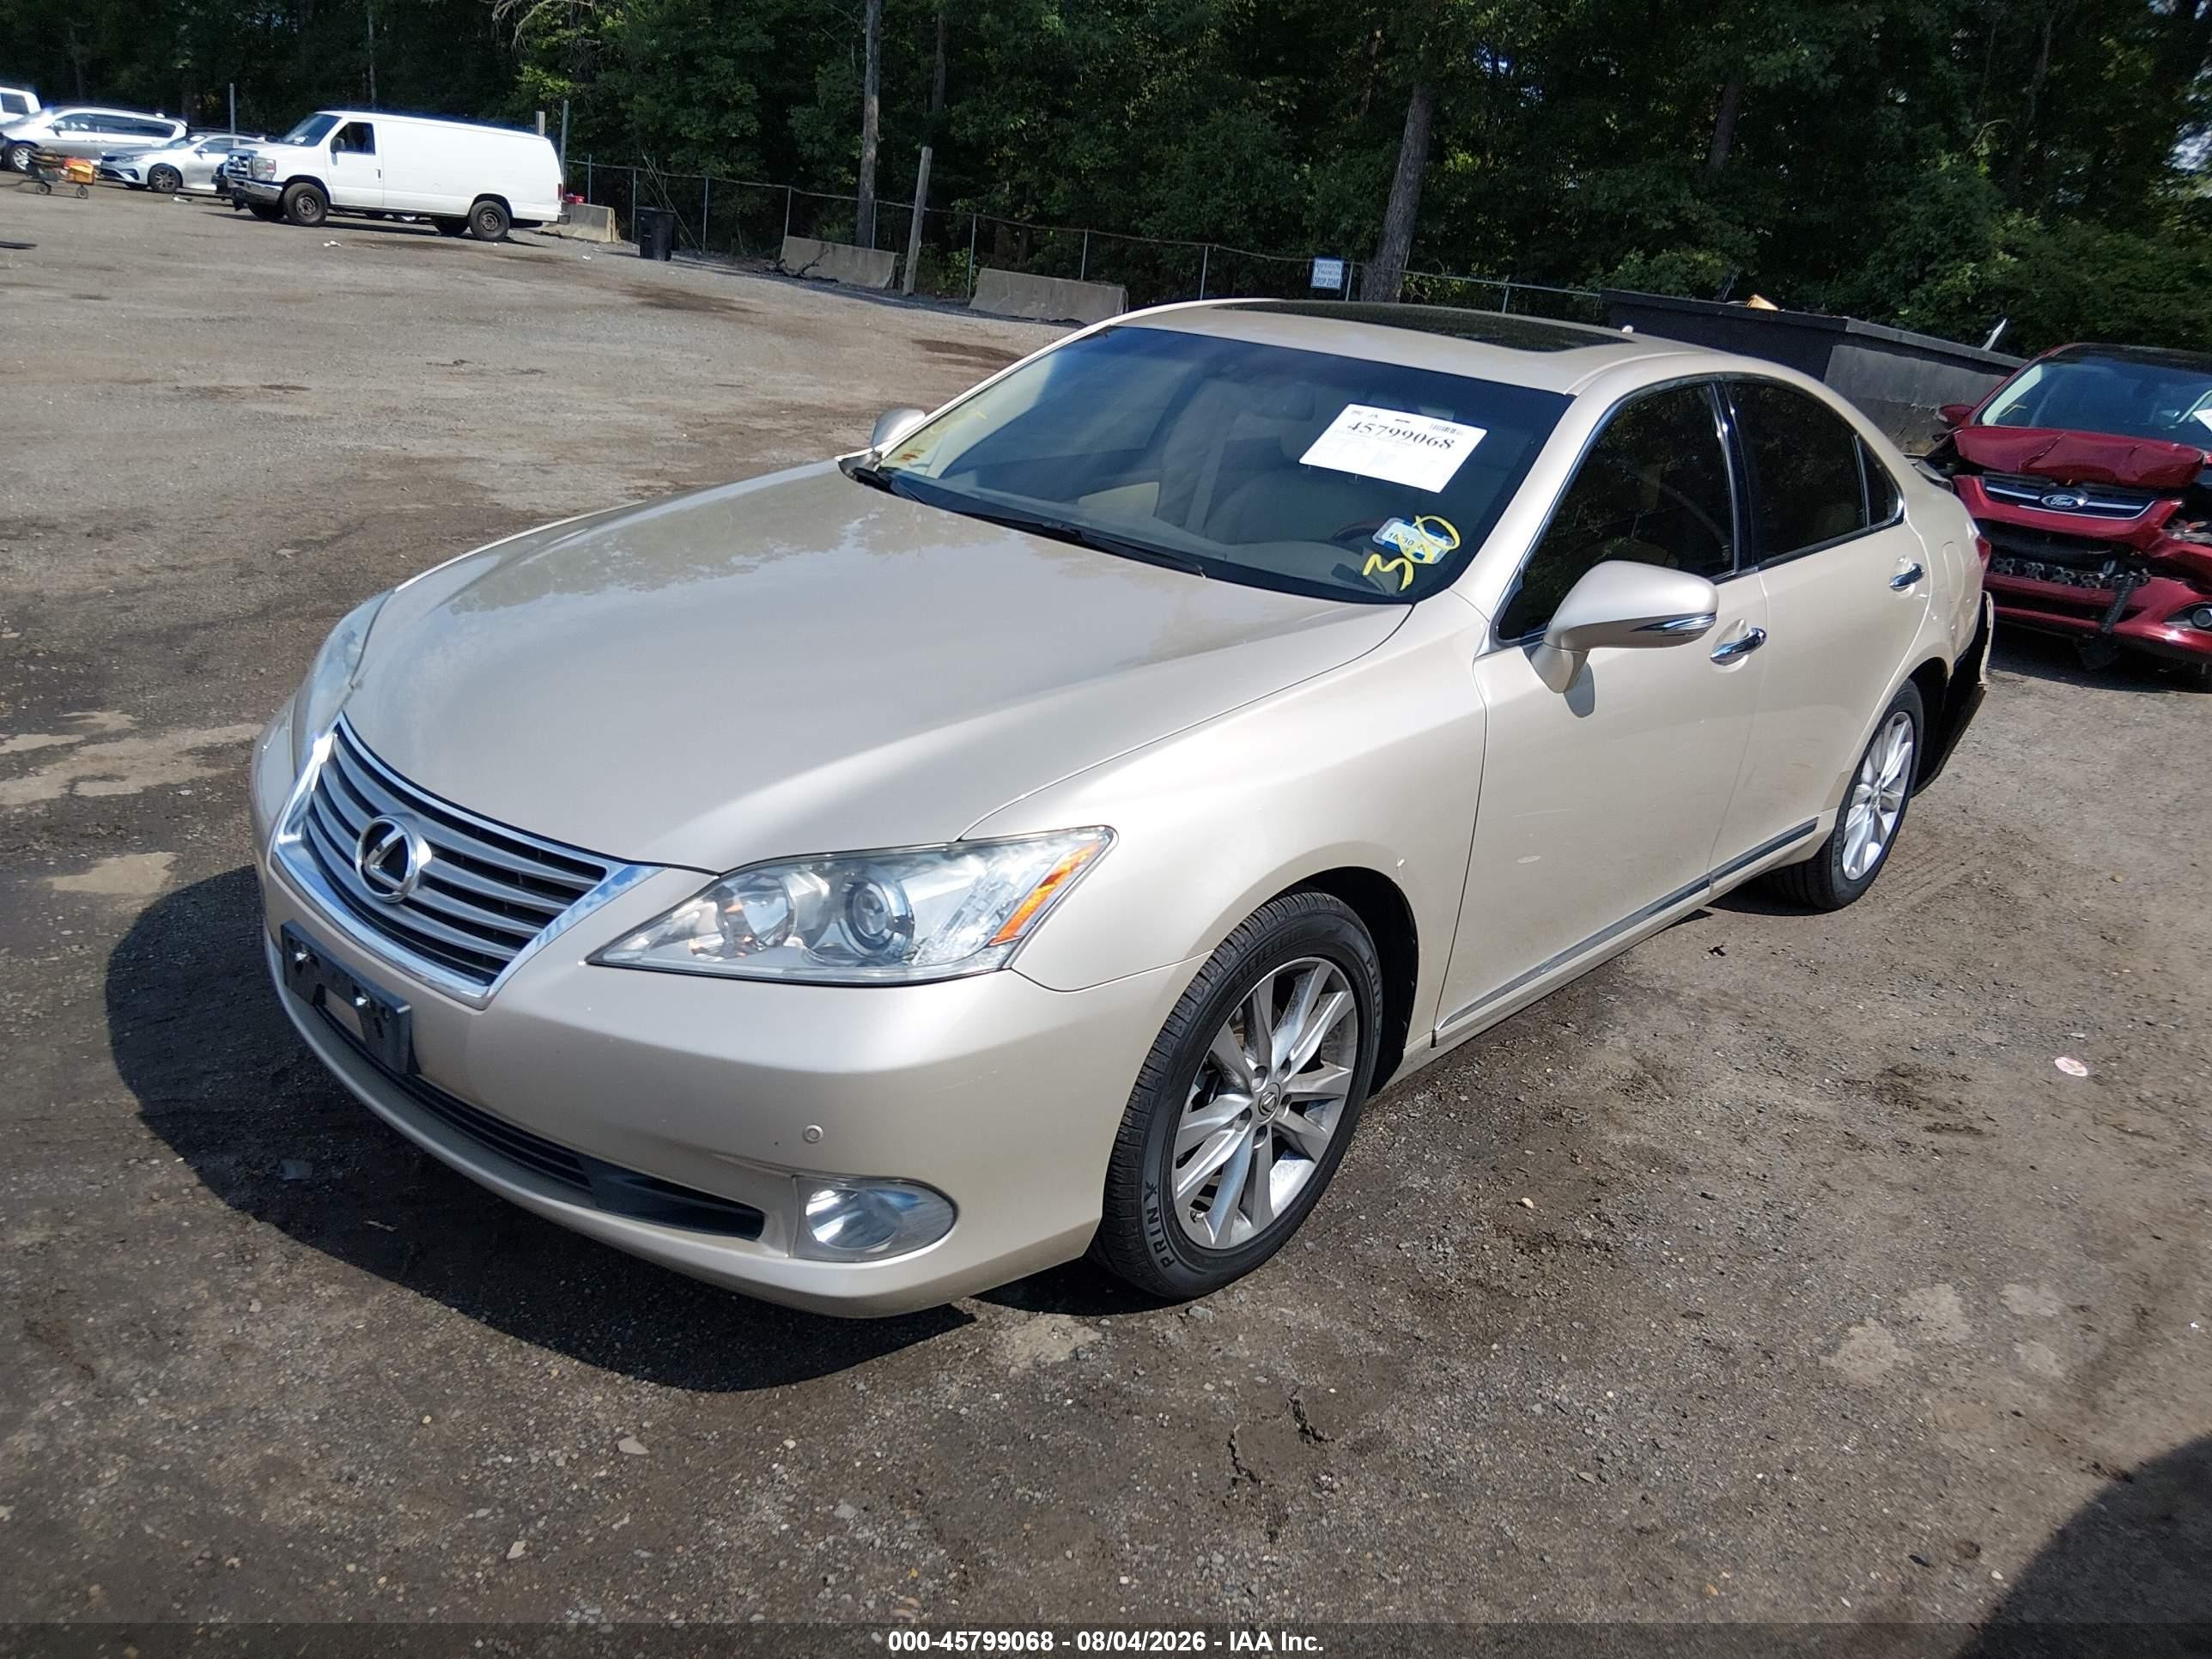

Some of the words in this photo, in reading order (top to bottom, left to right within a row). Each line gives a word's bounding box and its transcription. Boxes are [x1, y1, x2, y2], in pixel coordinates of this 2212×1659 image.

[1347, 422, 1455, 449] 45799068
[2050, 497, 2075, 507] Ford
[1143, 1181, 1176, 1268] PRINX
